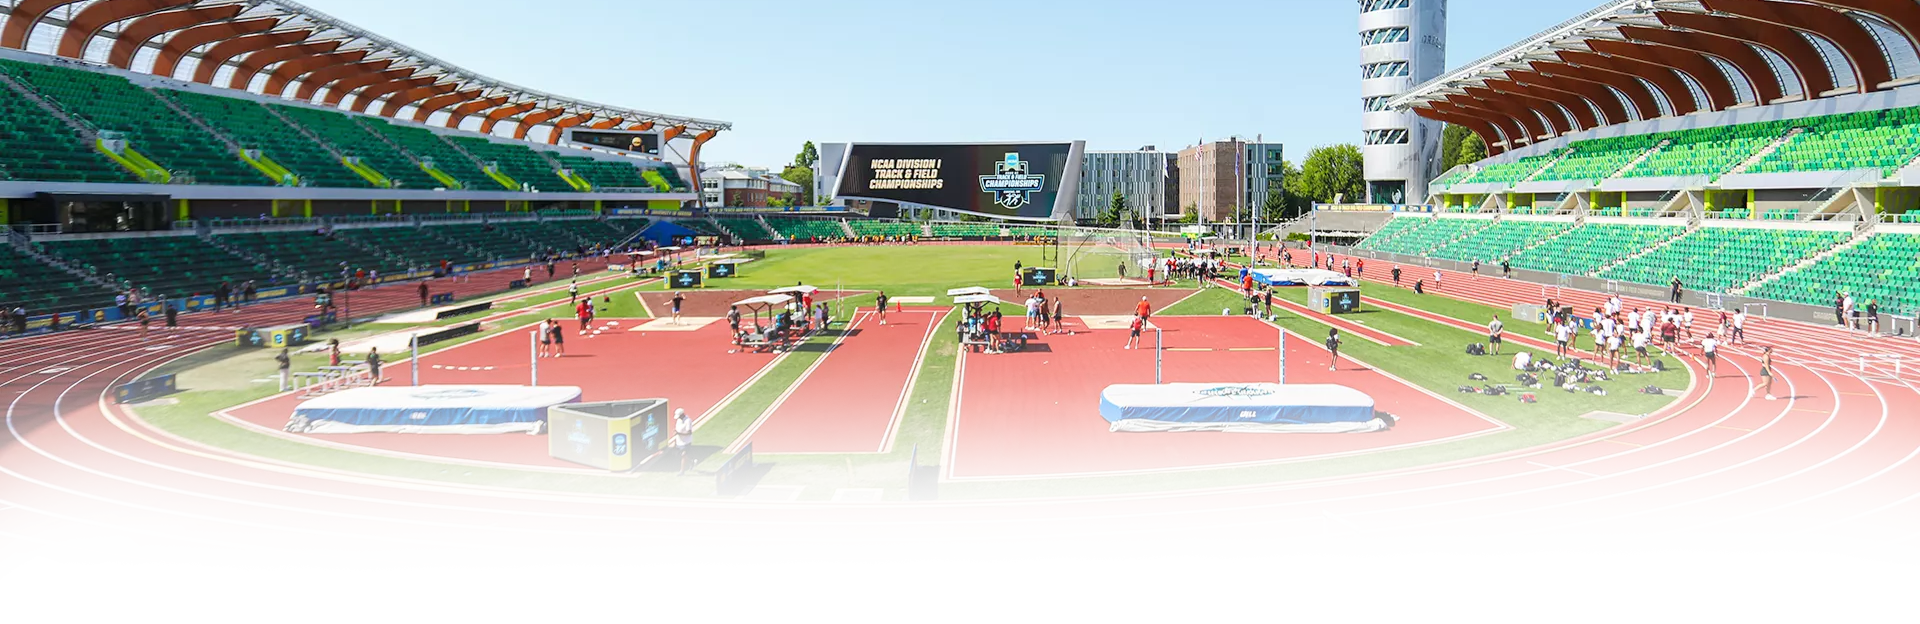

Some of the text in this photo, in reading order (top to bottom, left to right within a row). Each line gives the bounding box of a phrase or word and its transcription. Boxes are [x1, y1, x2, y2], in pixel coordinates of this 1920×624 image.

[870, 159, 942, 169] NCAA DIVISION I
[875, 169, 938, 179] TRACK & FIELD
[869, 179, 943, 189] CHAMPIONSHIPS
[985, 179, 1039, 188] CHAMPIONSHIPS
